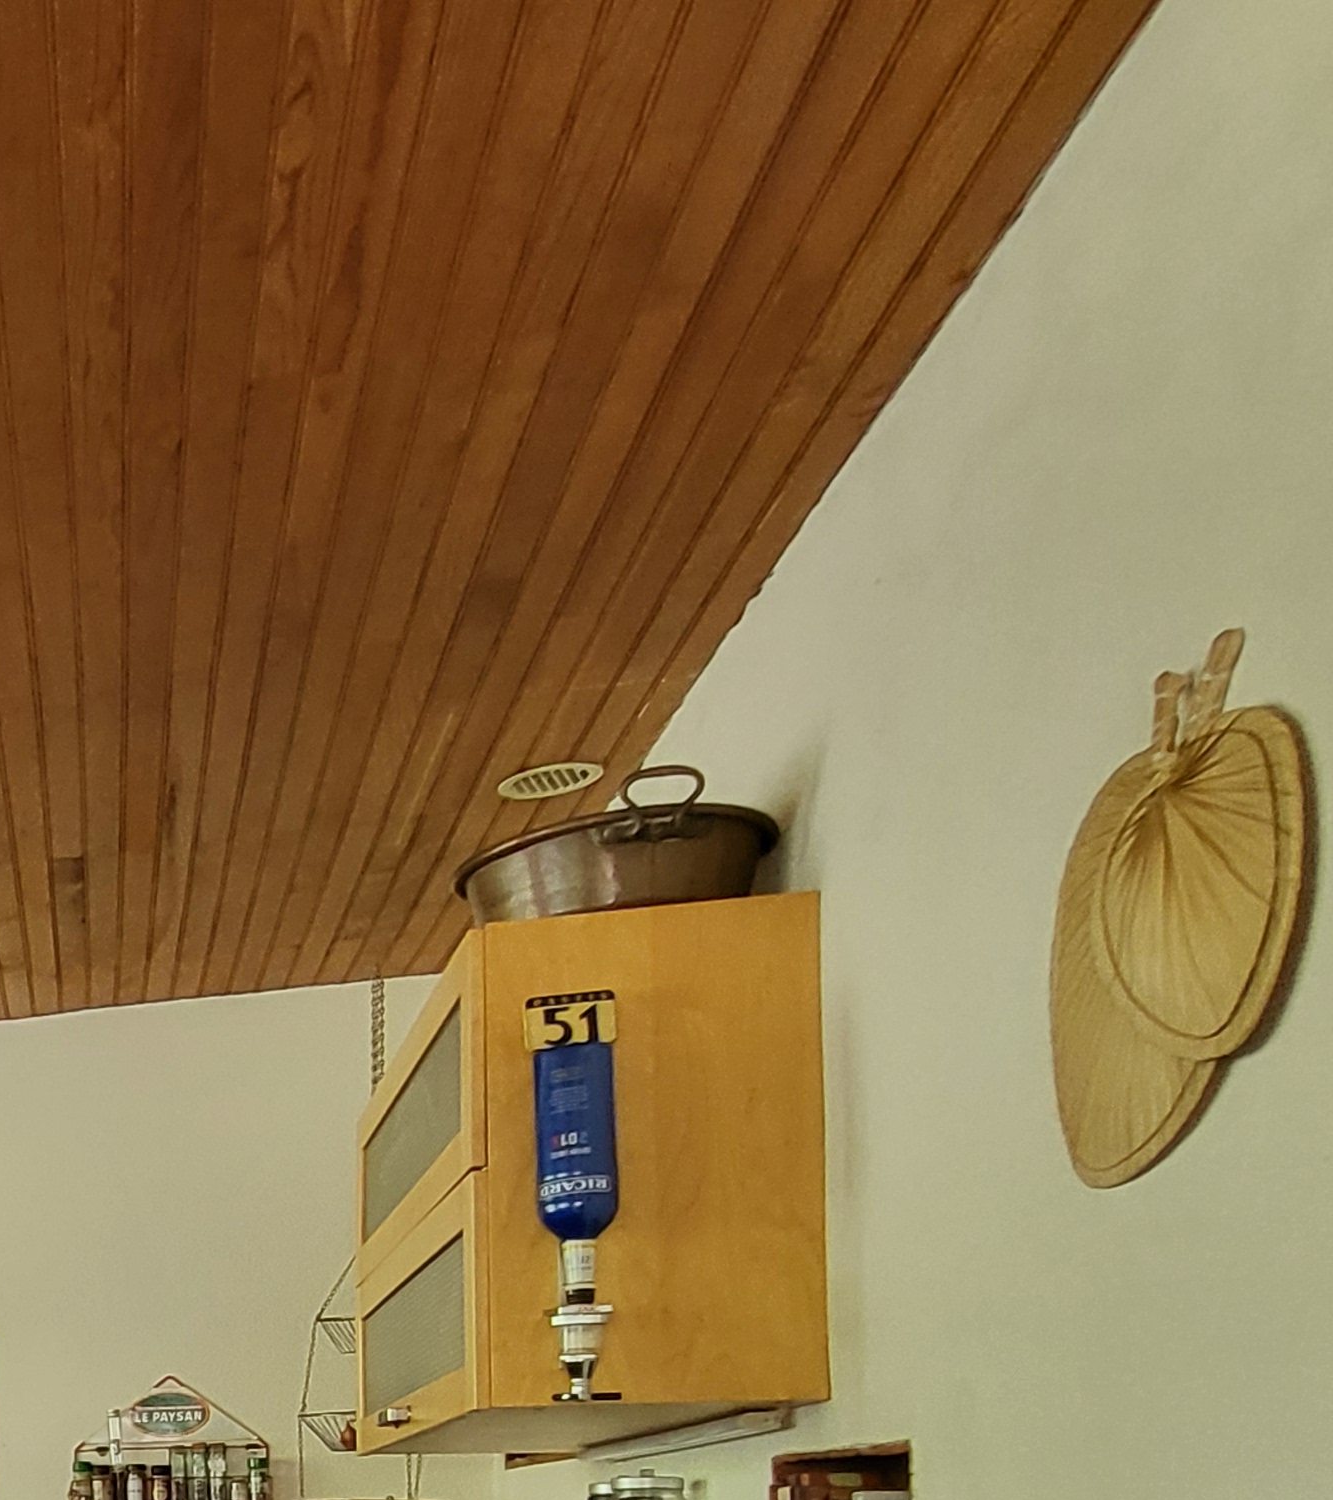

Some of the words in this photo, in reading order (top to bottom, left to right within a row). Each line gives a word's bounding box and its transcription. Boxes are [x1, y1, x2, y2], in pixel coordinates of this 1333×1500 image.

[543, 1004, 599, 1045] 51
[540, 1178, 607, 1197] RICARD
[134, 1412, 149, 1423] LE
[152, 1410, 203, 1422] PAYSAN
